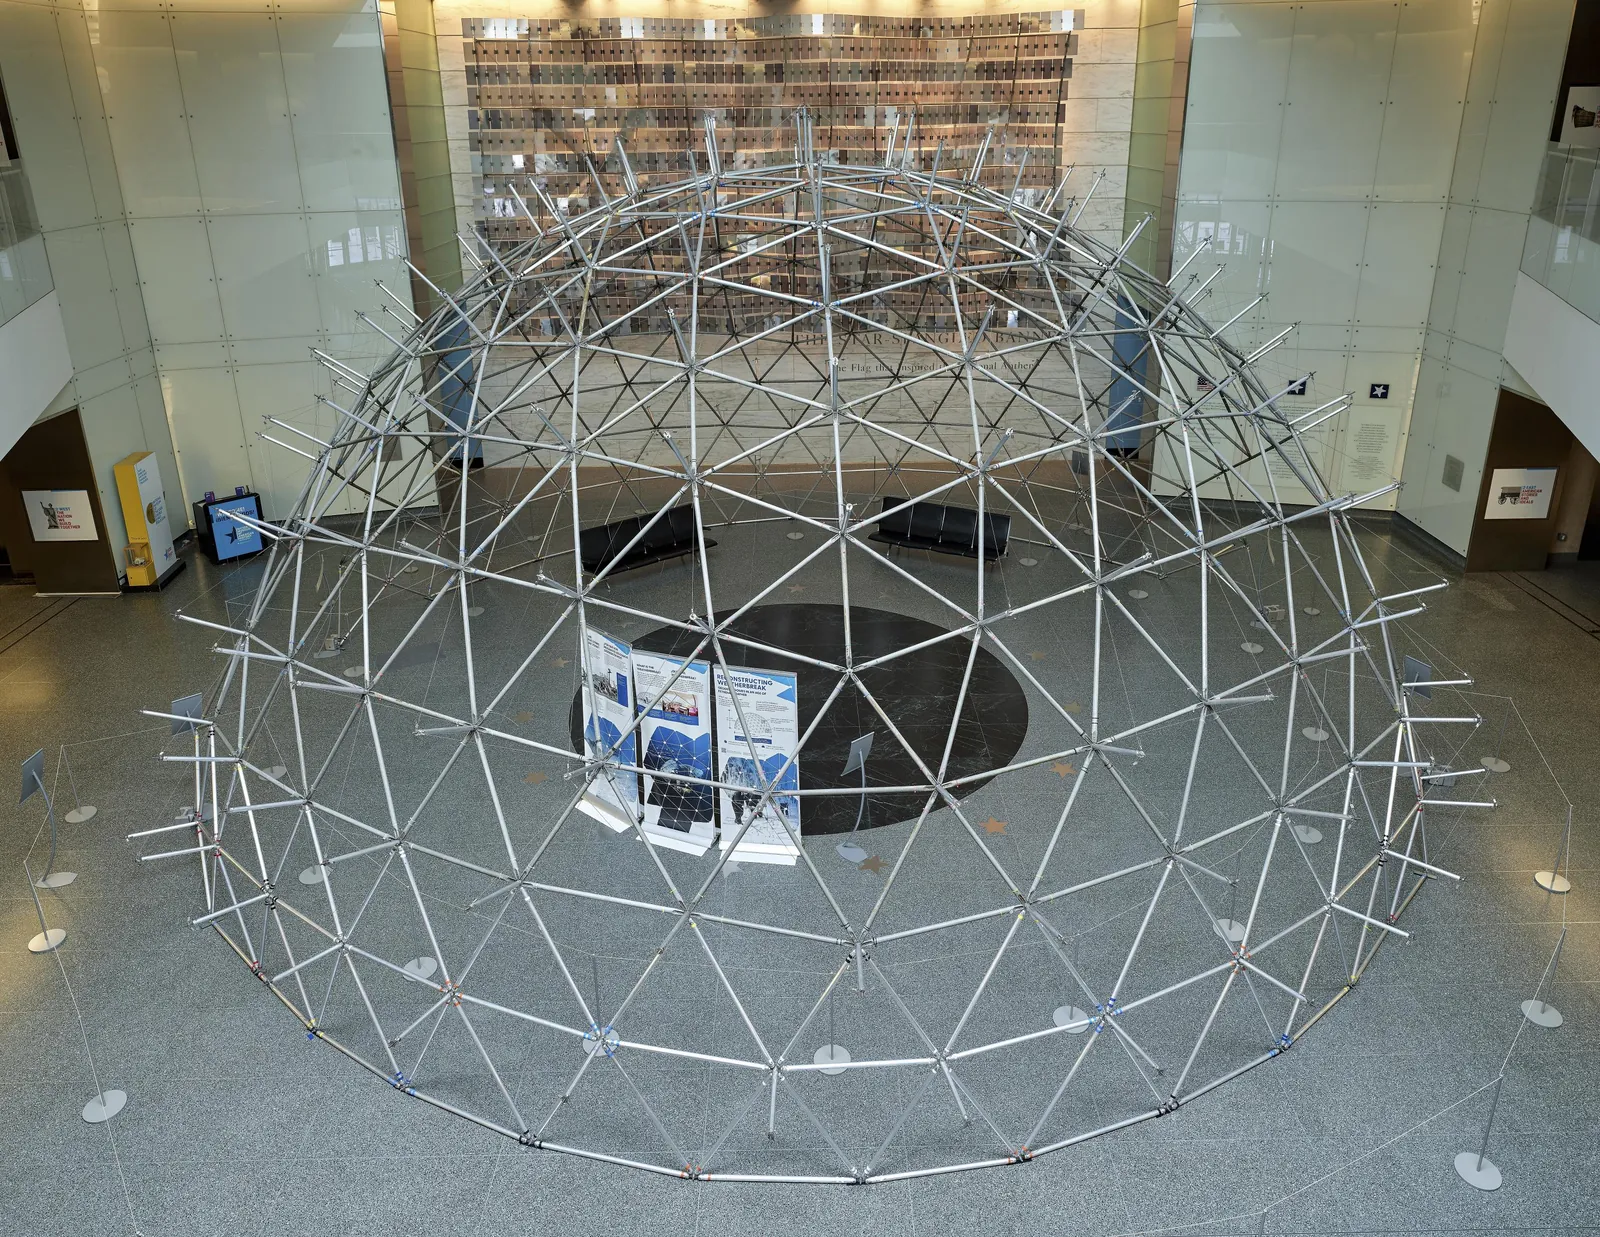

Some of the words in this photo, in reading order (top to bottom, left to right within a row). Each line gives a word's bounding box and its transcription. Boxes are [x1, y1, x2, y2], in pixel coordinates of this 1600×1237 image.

[838, 331, 986, 345] STAR-SNGLED
[996, 330, 1058, 343] BANNE
[851, 363, 872, 374] Flag
[898, 362, 935, 373] nspired
[717, 679, 767, 691] WEHERBREAK
